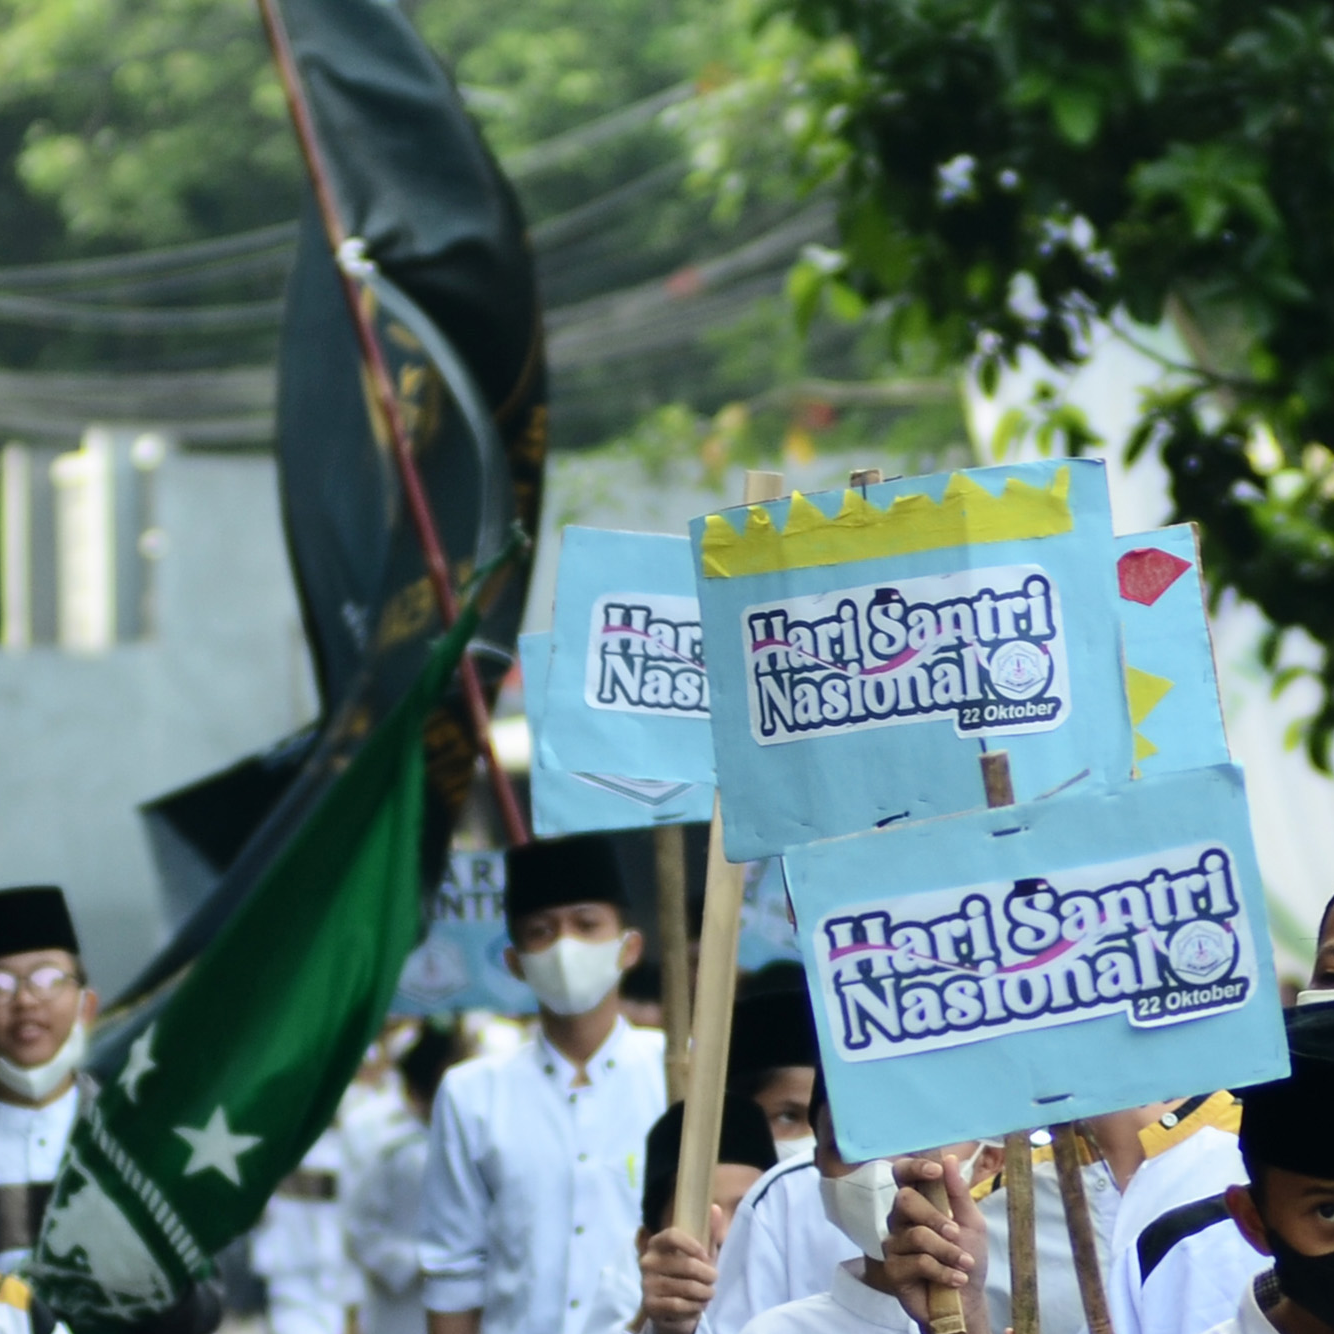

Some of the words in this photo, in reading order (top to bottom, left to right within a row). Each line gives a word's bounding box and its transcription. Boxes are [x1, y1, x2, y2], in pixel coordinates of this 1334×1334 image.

[601, 602, 703, 660] Har
[749, 601, 860, 673] Hari
[868, 576, 1055, 658] Santri
[754, 645, 987, 734] Nasional
[962, 707, 981, 725] 22
[983, 701, 1056, 722] Oktober
[827, 895, 997, 985] Hari
[1008, 851, 1238, 953] Santri
[840, 932, 1164, 1048] Nasional
[1137, 997, 1162, 1017] 22
[1165, 981, 1244, 1011] Oktober
